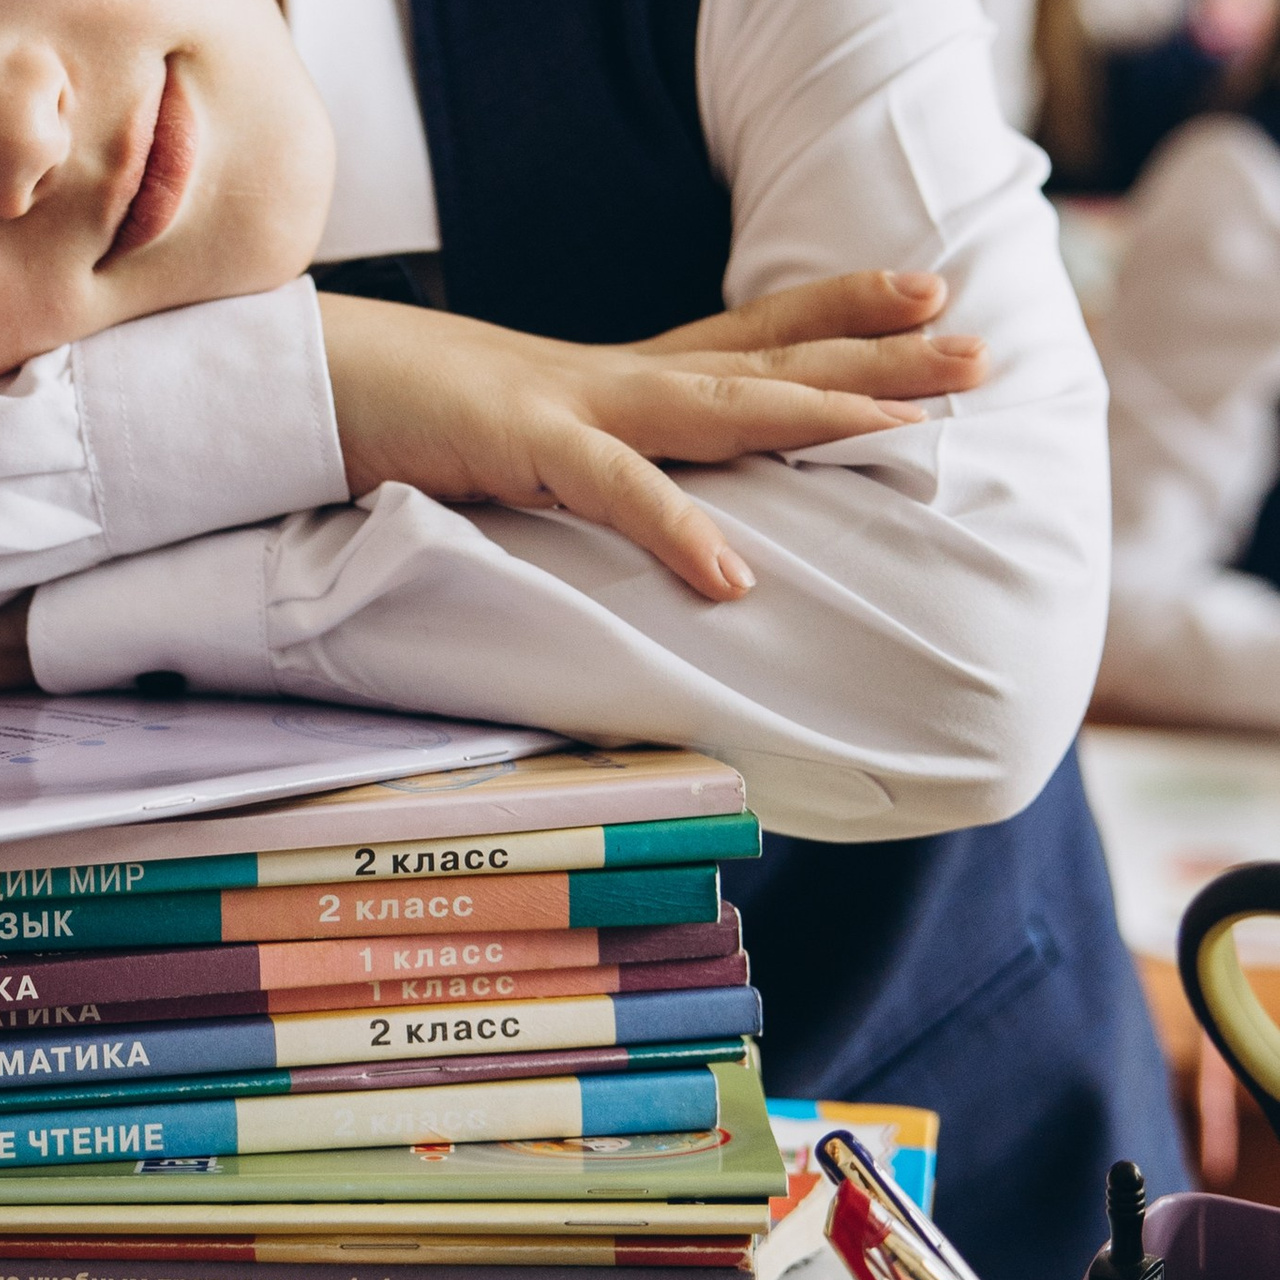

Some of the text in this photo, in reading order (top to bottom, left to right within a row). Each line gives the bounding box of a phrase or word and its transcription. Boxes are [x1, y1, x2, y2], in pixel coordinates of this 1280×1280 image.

[353, 846, 510, 877] 2 класс
[68, 862, 146, 894] МИР
[317, 893, 475, 923] 2 класс
[359, 941, 505, 973] 1 класс
[368, 975, 516, 1001] 1 класс
[369, 1016, 521, 1047] 2 класс
[27, 1122, 165, 1157] ЧТЕНИЕ
